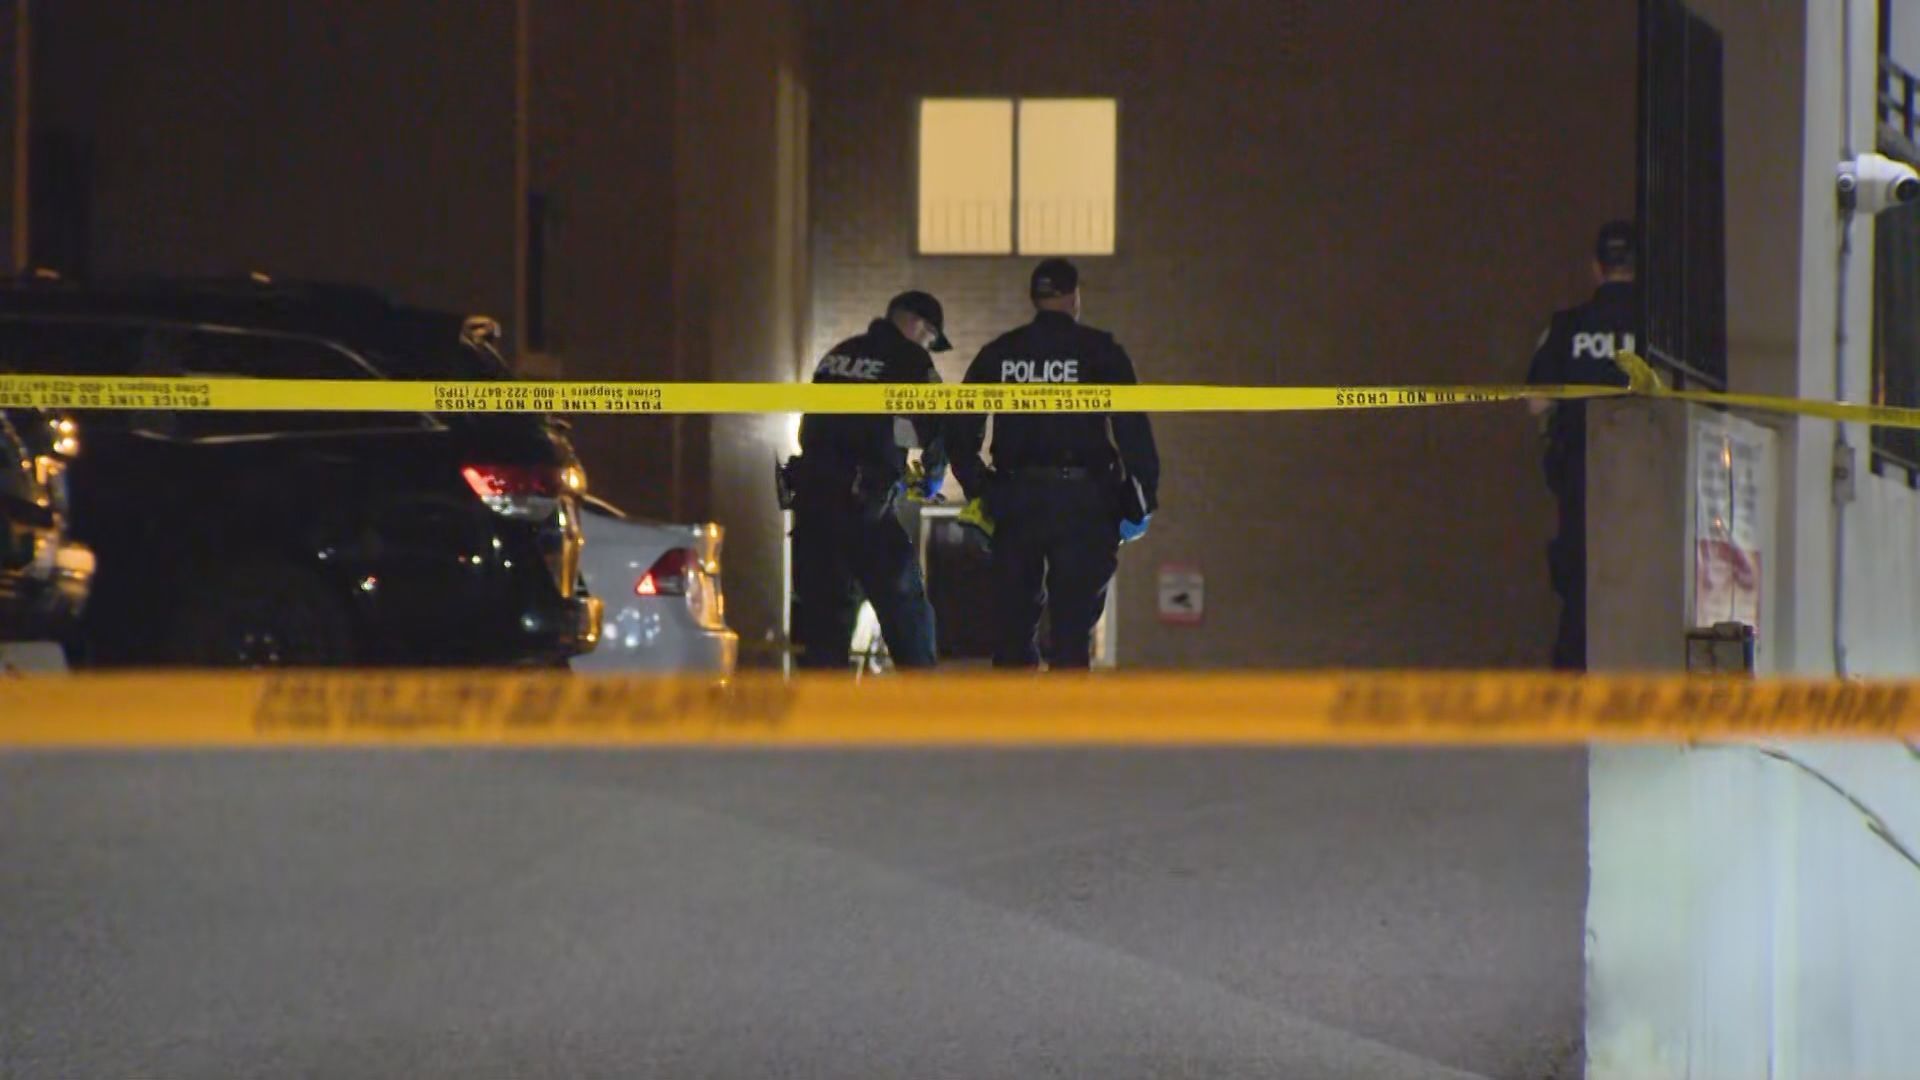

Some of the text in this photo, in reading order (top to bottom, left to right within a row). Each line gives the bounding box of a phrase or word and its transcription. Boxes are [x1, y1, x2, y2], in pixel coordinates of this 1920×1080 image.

[1571, 333, 1636, 358] POLI
[818, 354, 884, 379] POLICE
[1001, 360, 1079, 383] POLICE
[571, 386, 623, 398] Stoppers
[627, 388, 662, 398] Crime
[1021, 387, 1073, 398] Stoppers
[1077, 388, 1112, 398] Crime
[1398, 391, 1427, 403] NOT
[0, 394, 211, 407] POLICE LINE DO NOT CRO
[434, 399, 662, 410] POLICE LINE DO NOT CROSS
[884, 399, 1112, 410] POLICE LINE DO NOT CROSS
[1335, 392, 1388, 405] CROSS
